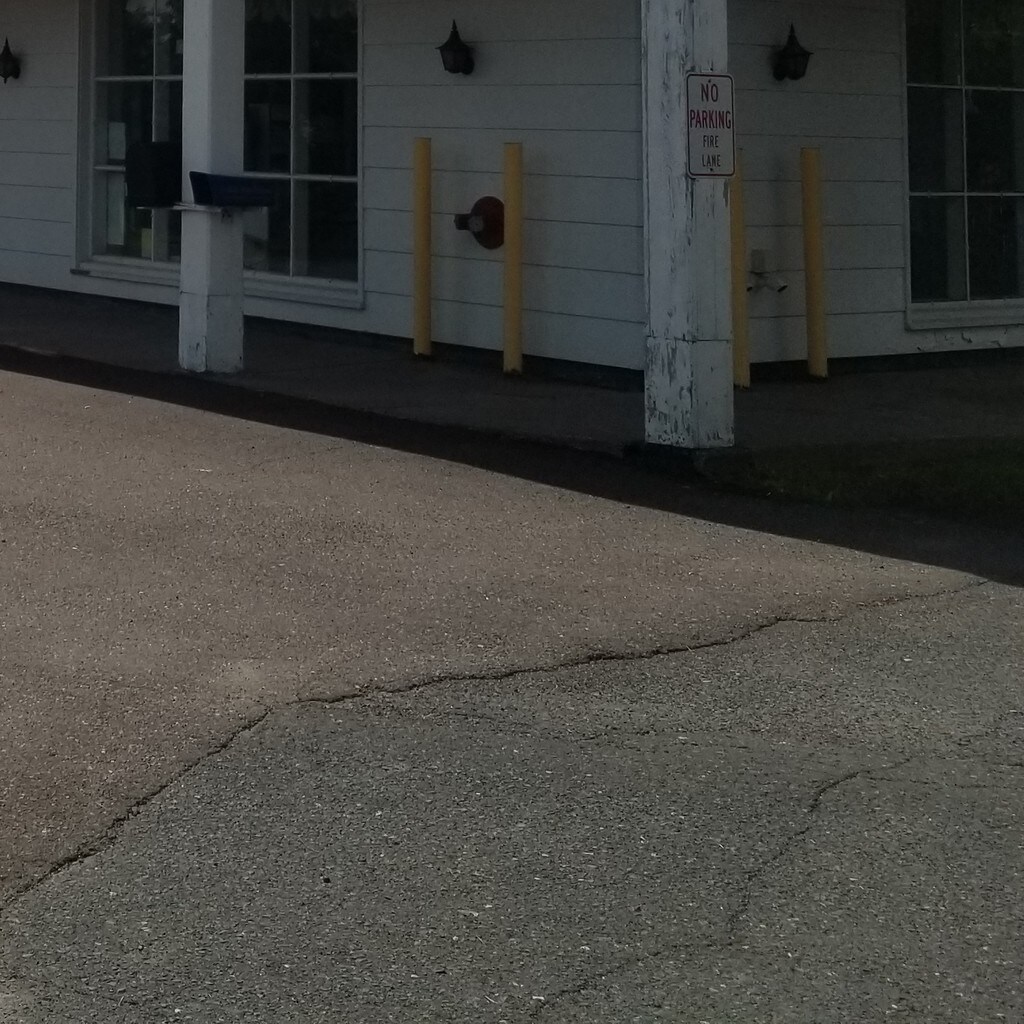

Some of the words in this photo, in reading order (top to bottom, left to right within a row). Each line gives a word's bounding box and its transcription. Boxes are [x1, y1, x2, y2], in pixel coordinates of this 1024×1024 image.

[701, 83, 718, 102] NO
[690, 109, 731, 129] PARKING
[703, 135, 719, 148] FIRE
[702, 154, 721, 167] LANE
